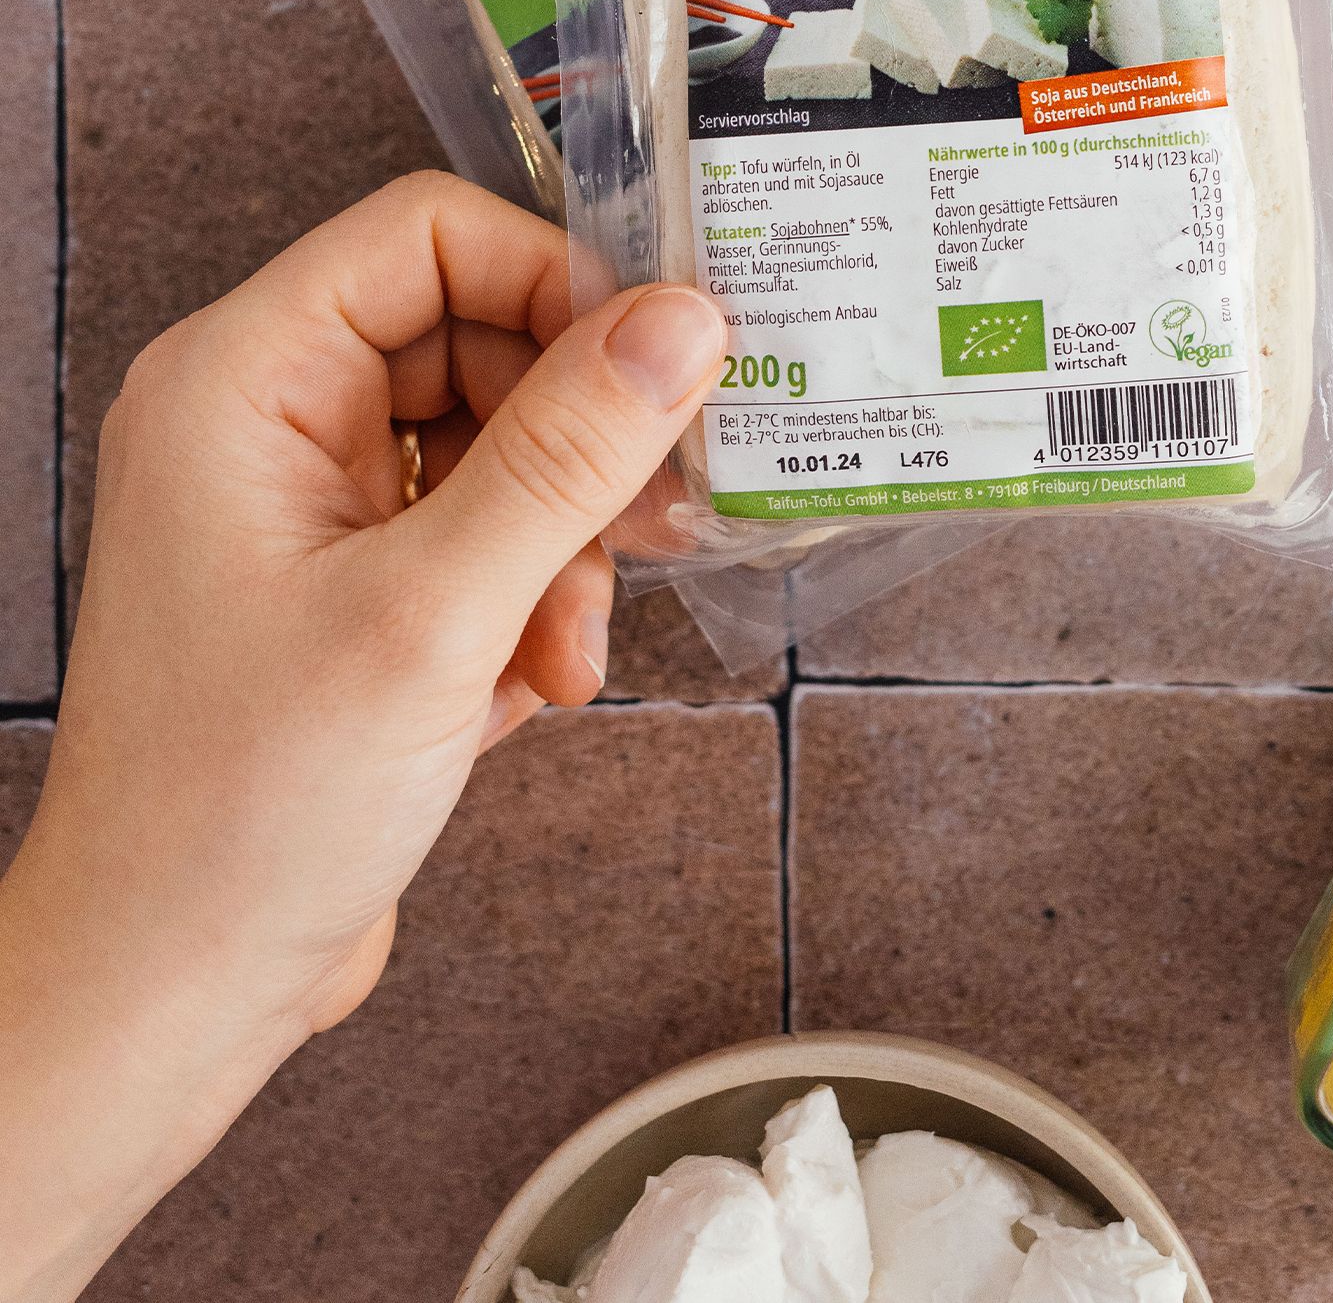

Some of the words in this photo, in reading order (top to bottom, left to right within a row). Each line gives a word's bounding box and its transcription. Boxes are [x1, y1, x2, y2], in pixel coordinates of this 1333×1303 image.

[1031, 90, 1061, 107] Soja
[1064, 85, 1089, 101] aus
[1091, 71, 1182, 97] Deutschland,
[1033, 103, 1107, 124] Österreich
[1109, 97, 1137, 114] und
[1140, 88, 1211, 110] Frankreich
[698, 108, 810, 129] Serviervorschlag
[929, 144, 1009, 162] Nährwerte
[1013, 142, 1027, 156] in
[1074, 130, 1210, 156] (durchschnittlich):
[701, 162, 737, 181] Tipp:
[740, 160, 768, 175] Tofu
[773, 155, 825, 173] würfeln,
[830, 156, 842, 170] in
[846, 151, 860, 168] Öl
[1114, 155, 1139, 170] 514
[1142, 152, 1154, 170] kJ
[1157, 151, 1187, 169] (123
[1190, 148, 1220, 166] kcal)
[702, 180, 760, 196] anbraten
[764, 176, 789, 192] und
[794, 175, 815, 190] mit
[819, 172, 884, 191] Sojasauce
[929, 166, 979, 183] Energie
[1189, 168, 1209, 184] 6,7
[930, 185, 955, 200] Fett
[1191, 186, 1210, 203] 1,2
[703, 196, 772, 214] ablöschen.
[935, 202, 976, 218] davon
[979, 197, 1045, 220] gesättigte
[1048, 193, 1118, 210] Fettsäuren
[1192, 204, 1212, 220] 1,3
[704, 226, 767, 241] Zutaten:
[861, 215, 893, 232] 55%,
[933, 218, 1028, 240] Kohlenhydrate
[1193, 223, 1213, 239] 0,5
[706, 244, 755, 259] Wasser,
[759, 238, 841, 258] Gerinnungs-
[938, 237, 978, 255] davon
[981, 236, 1025, 252] Zucker
[1198, 241, 1214, 255] 14
[708, 261, 748, 277] mittel:
[752, 253, 878, 279] Magnesiumchlorid,
[935, 256, 978, 273] Eiweiß
[1187, 260, 1214, 276] 0,01
[710, 277, 798, 295] Calciumsulfat.
[936, 275, 962, 291] Salz
[724, 314, 742, 326] us
[746, 307, 831, 328] biologischem
[835, 305, 877, 320] Anbau
[1221, 297, 1231, 322] 01/23
[1053, 322, 1136, 340] DE-ÖKO-007
[1054, 339, 1120, 356] EU-Land-
[1164, 332, 1232, 367] Vegan
[719, 355, 780, 388] 200
[1054, 354, 1128, 371] wirtschaft
[719, 413, 739, 428] Bei
[743, 413, 778, 427] 2-7°C
[783, 411, 859, 427] mindestens
[862, 406, 908, 422] haltbar
[913, 405, 935, 420] bis:
[721, 431, 740, 445] Bei
[745, 430, 781, 444] 2-7°C
[785, 432, 799, 443] zu
[803, 426, 885, 442] verbrauchen
[889, 424, 908, 438] bis
[912, 422, 944, 439] (CH):
[900, 450, 949, 468] L476
[1033, 448, 1046, 463] 4
[1060, 444, 1139, 462] 012359
[1151, 439, 1228, 458] 110107
[777, 452, 862, 473] 10.01.24
[766, 495, 842, 510] Taifun-Tofu
[845, 491, 888, 506] GmbH
[903, 488, 961, 503] Bebelstr.
[965, 487, 974, 500] 8
[987, 481, 1028, 497] 79108
[1033, 478, 1089, 495] Freiburg
[1101, 475, 1186, 492] Deutschland
